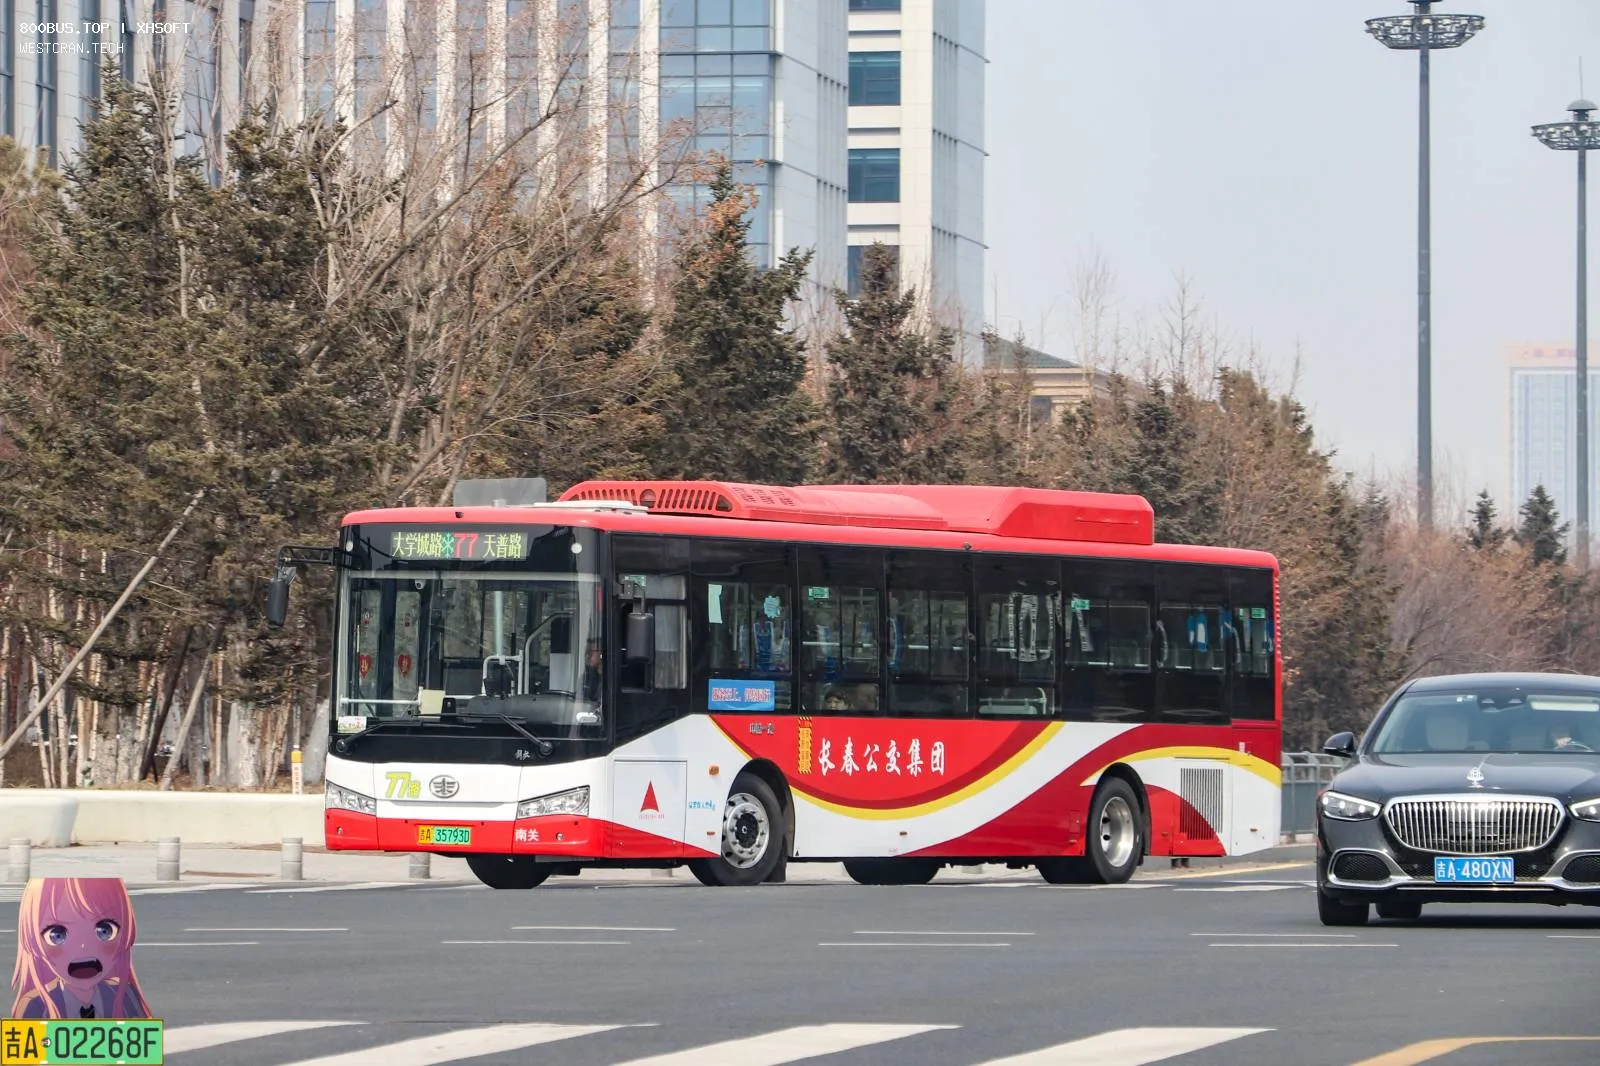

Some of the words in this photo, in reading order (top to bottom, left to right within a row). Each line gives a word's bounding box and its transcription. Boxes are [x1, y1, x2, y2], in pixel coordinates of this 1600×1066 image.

[392, 532, 442, 557] 大学城路
[454, 532, 479, 558] 77
[483, 533, 522, 558] 天普路
[818, 736, 945, 777] 长春公交集团
[515, 828, 539, 842] 南关
